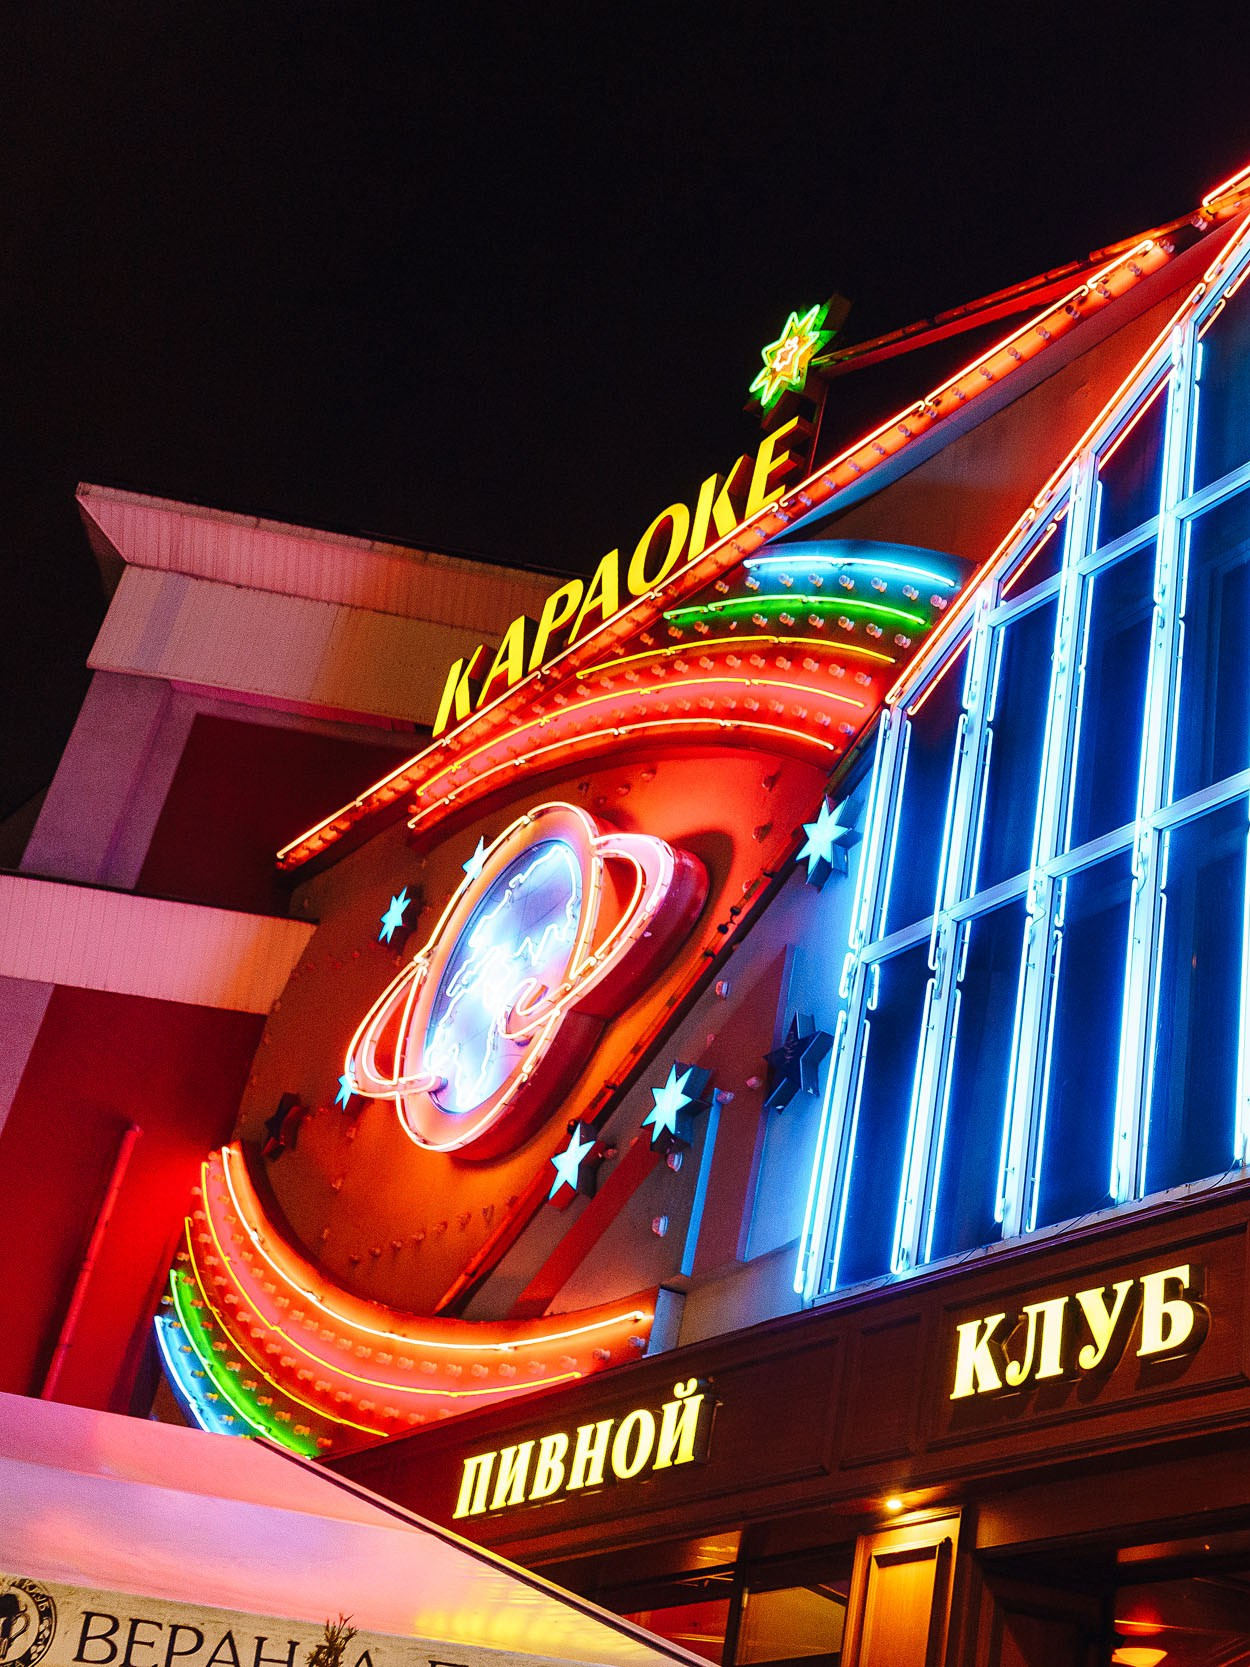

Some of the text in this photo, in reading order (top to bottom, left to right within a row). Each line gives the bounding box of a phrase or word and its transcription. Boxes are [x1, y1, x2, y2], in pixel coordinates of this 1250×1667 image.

[432, 415, 799, 738] КАРАОКЕ
[452, 1264, 1195, 1519] ПИВНОЙ КЛУБ
[72, 1610, 373, 1667] ВЕРАН
